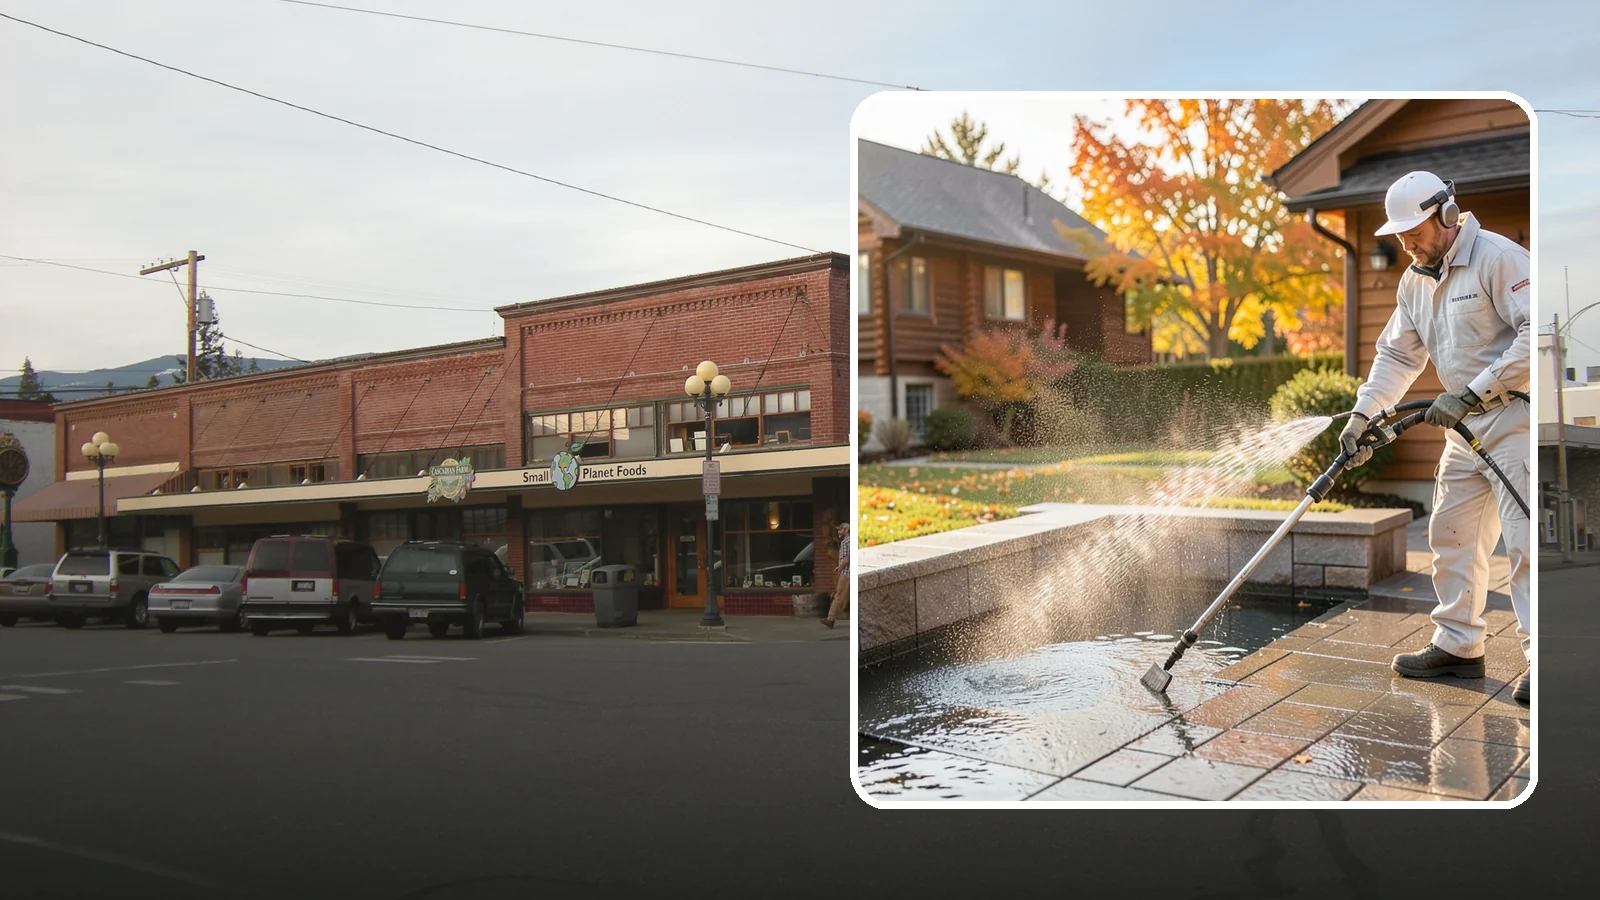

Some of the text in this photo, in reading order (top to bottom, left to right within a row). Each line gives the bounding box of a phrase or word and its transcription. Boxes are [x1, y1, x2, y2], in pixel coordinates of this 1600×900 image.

[523, 464, 647, 482] Small Planet Foods
